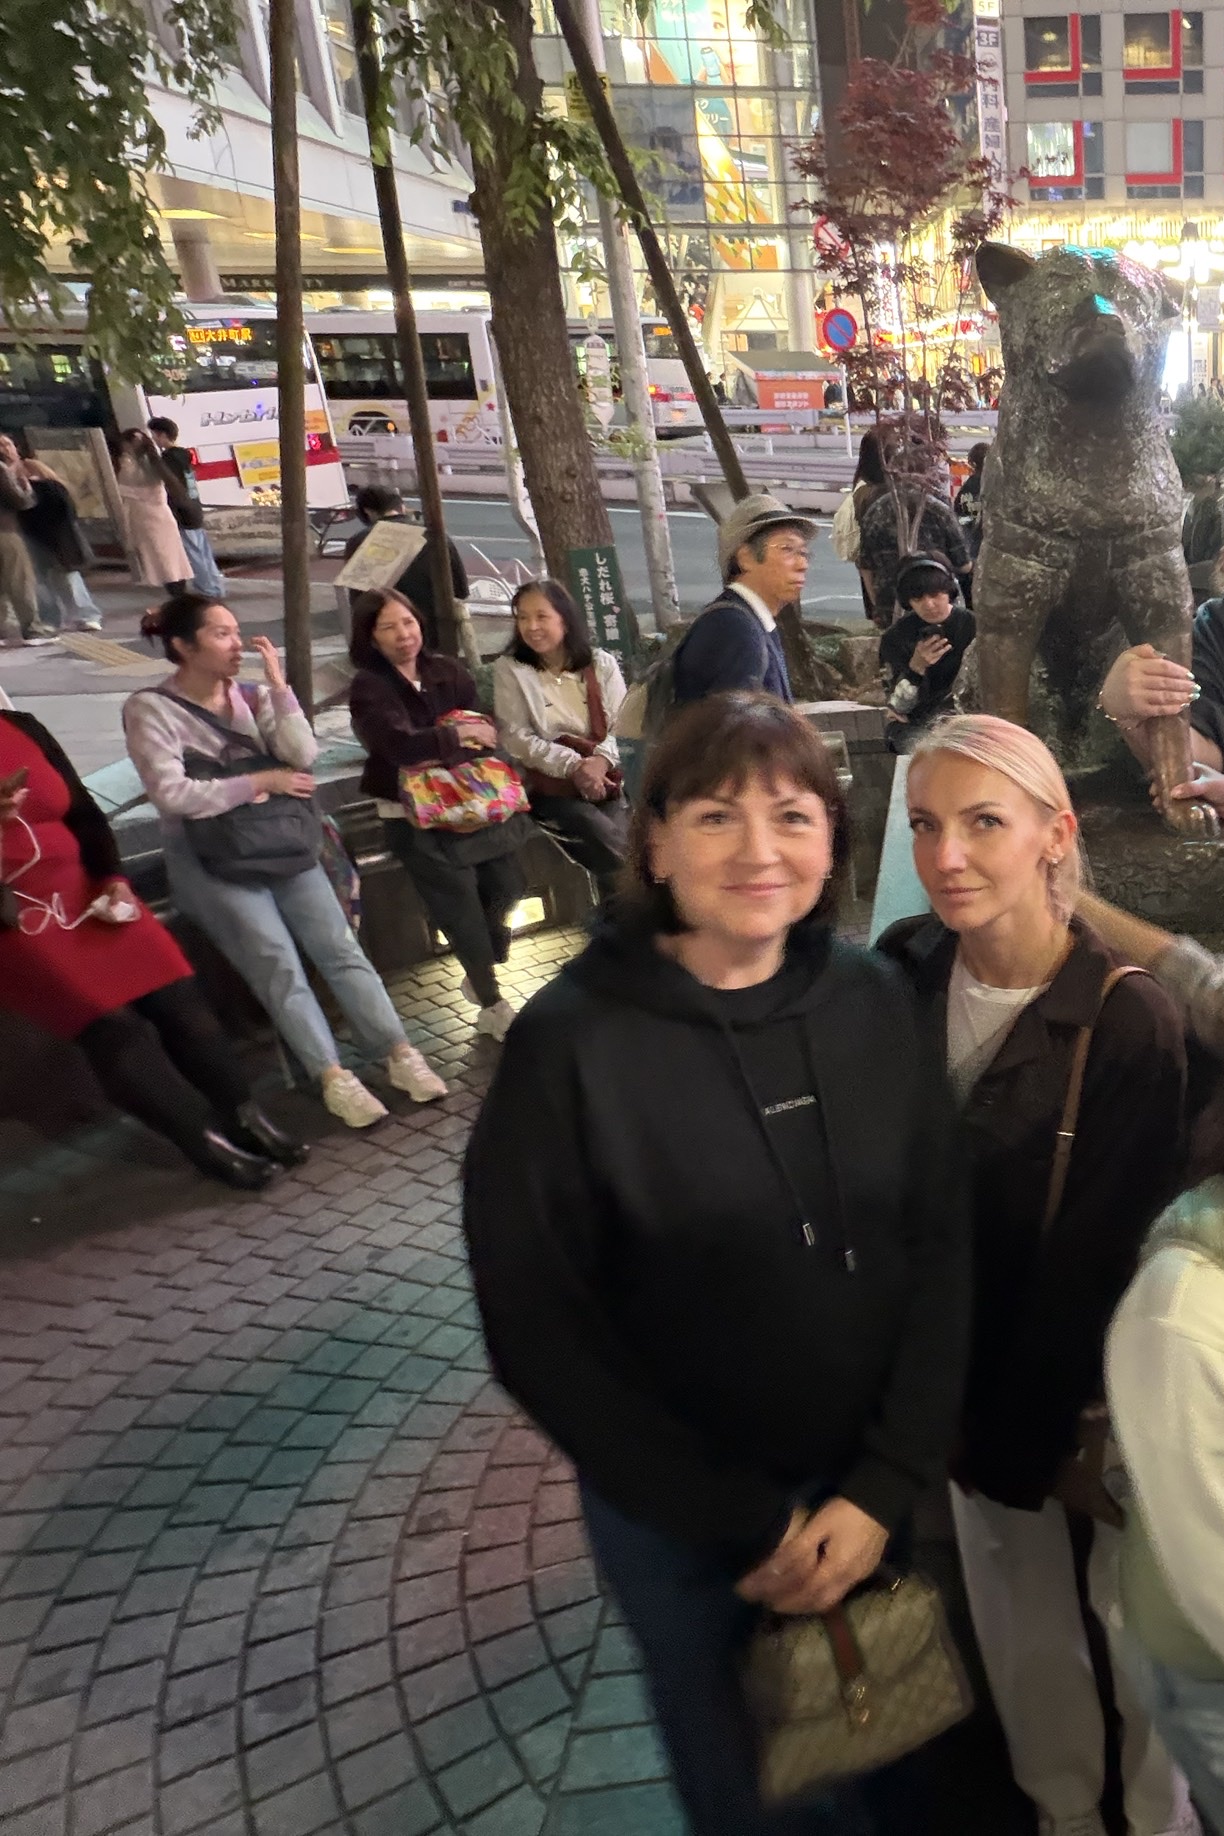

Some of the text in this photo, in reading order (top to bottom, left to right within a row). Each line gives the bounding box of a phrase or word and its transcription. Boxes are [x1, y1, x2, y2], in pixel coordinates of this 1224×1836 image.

[979, 32, 998, 46] 3F
[594, 551, 615, 606] しだれ桜
